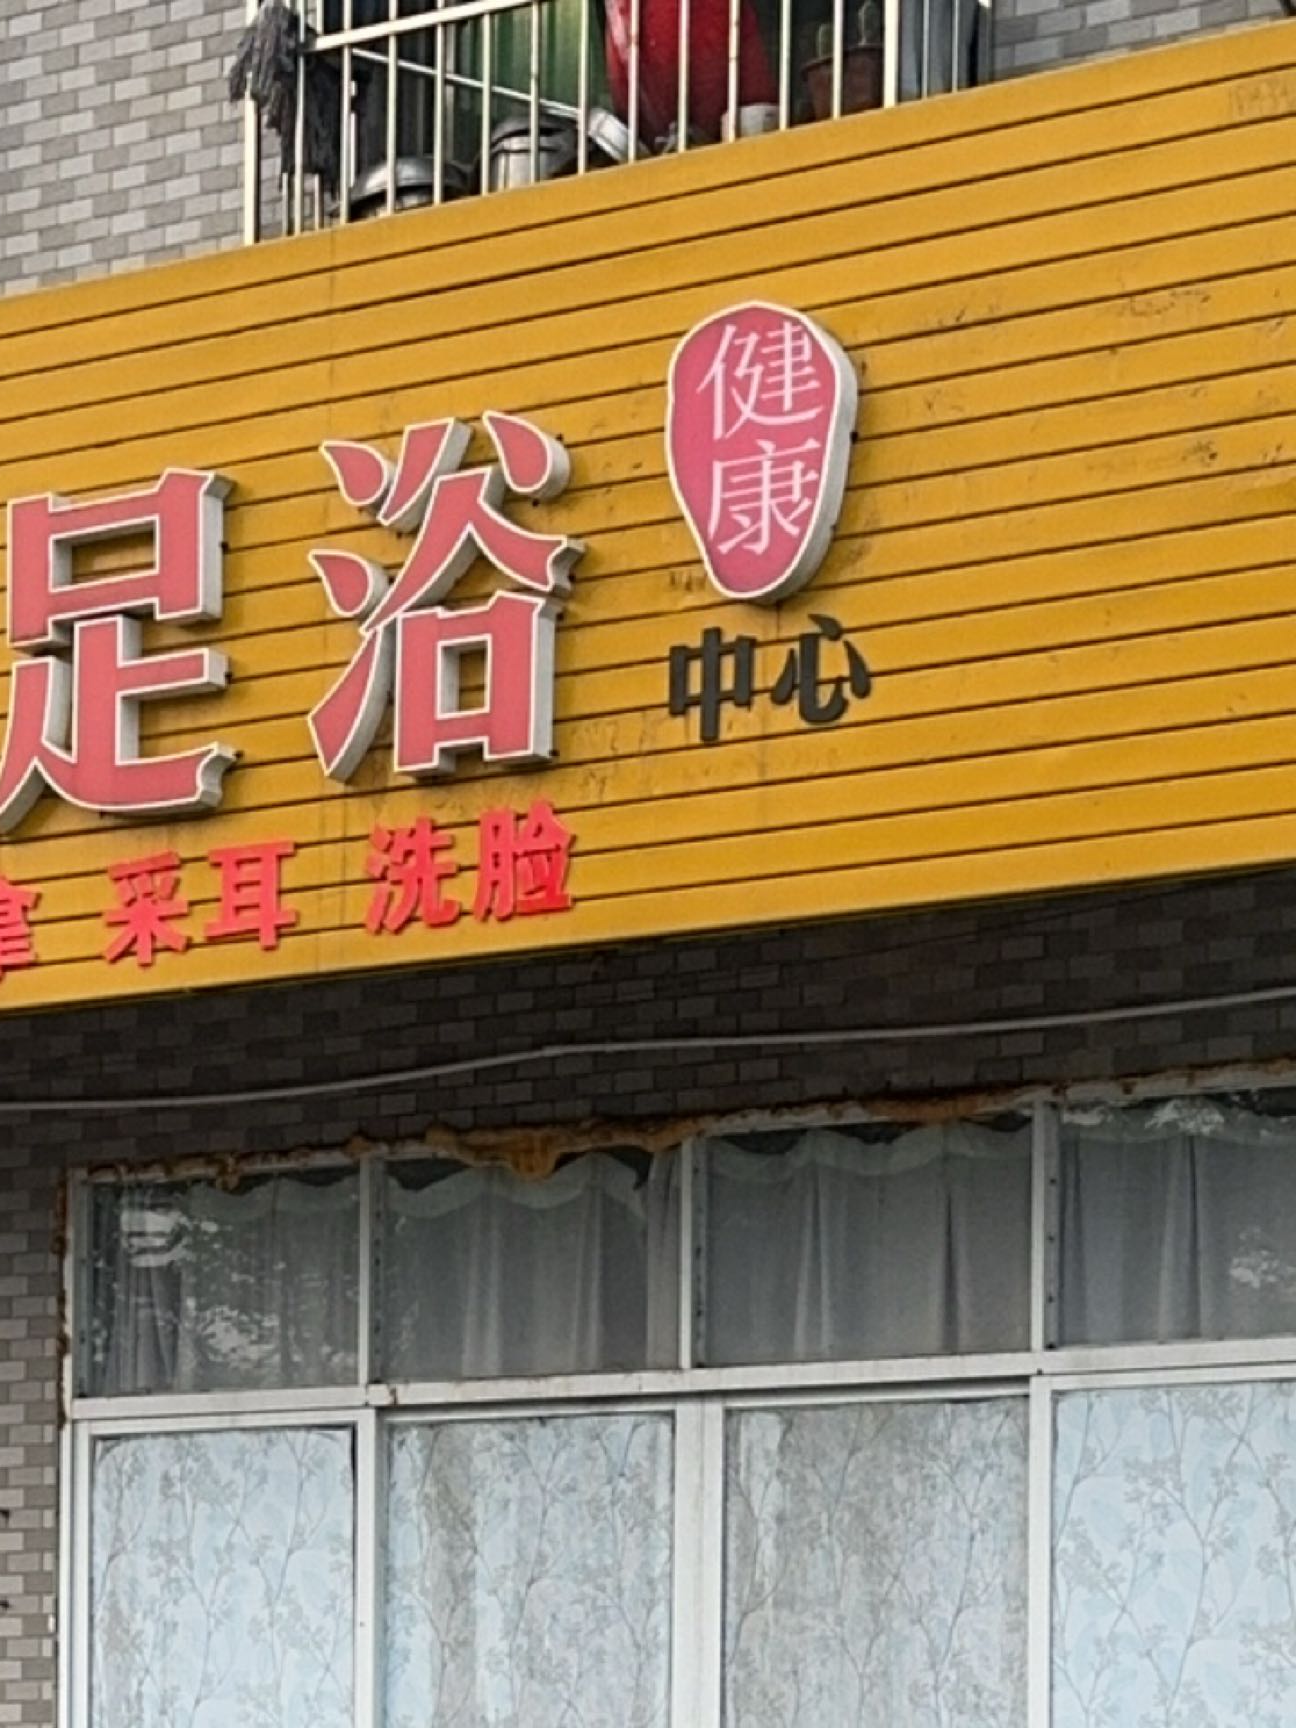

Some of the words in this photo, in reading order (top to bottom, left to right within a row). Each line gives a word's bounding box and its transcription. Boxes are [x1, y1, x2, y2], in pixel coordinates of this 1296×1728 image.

[695, 319, 825, 557] 健康
[667, 612, 873, 743] 中心
[103, 839, 299, 967] 采耳
[362, 798, 578, 938] 洗脸
